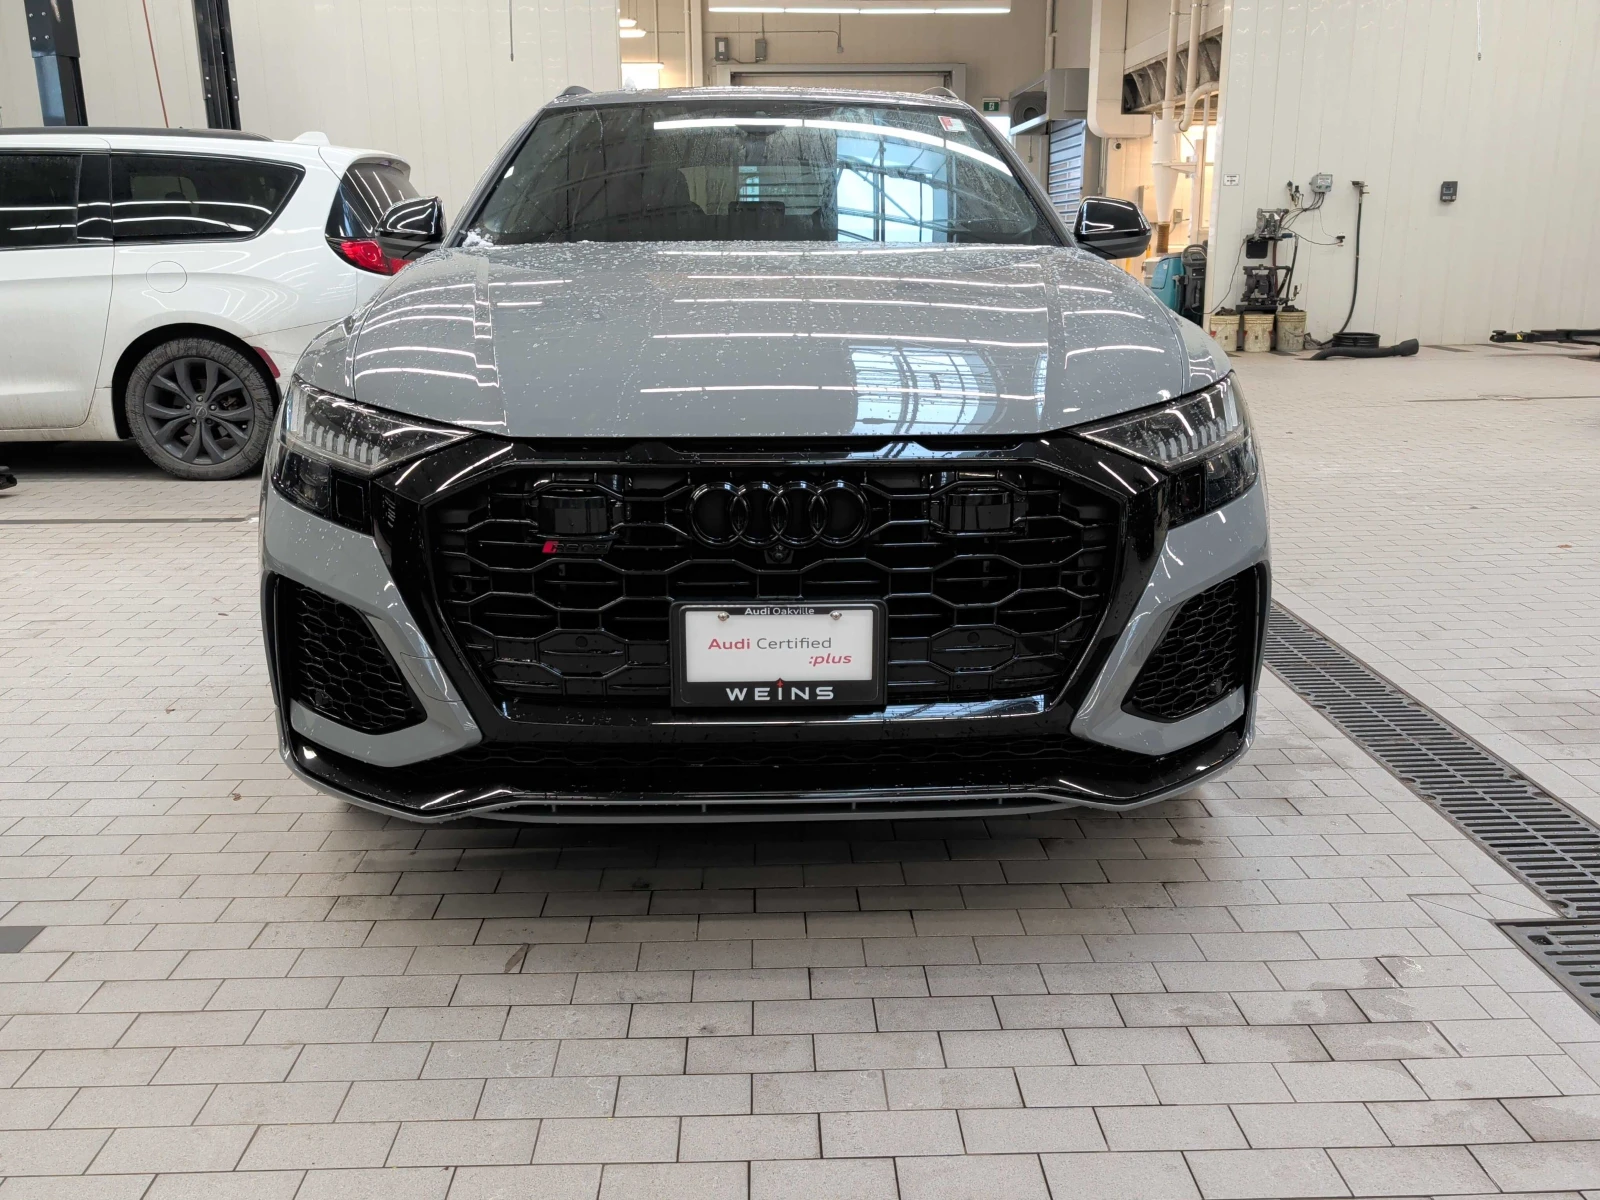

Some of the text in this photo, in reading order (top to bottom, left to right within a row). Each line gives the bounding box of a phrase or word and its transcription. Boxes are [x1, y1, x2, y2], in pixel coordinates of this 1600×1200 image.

[744, 607, 815, 615] Audi Oakville
[708, 637, 832, 650] Audi Certified
[808, 653, 852, 667] :plus
